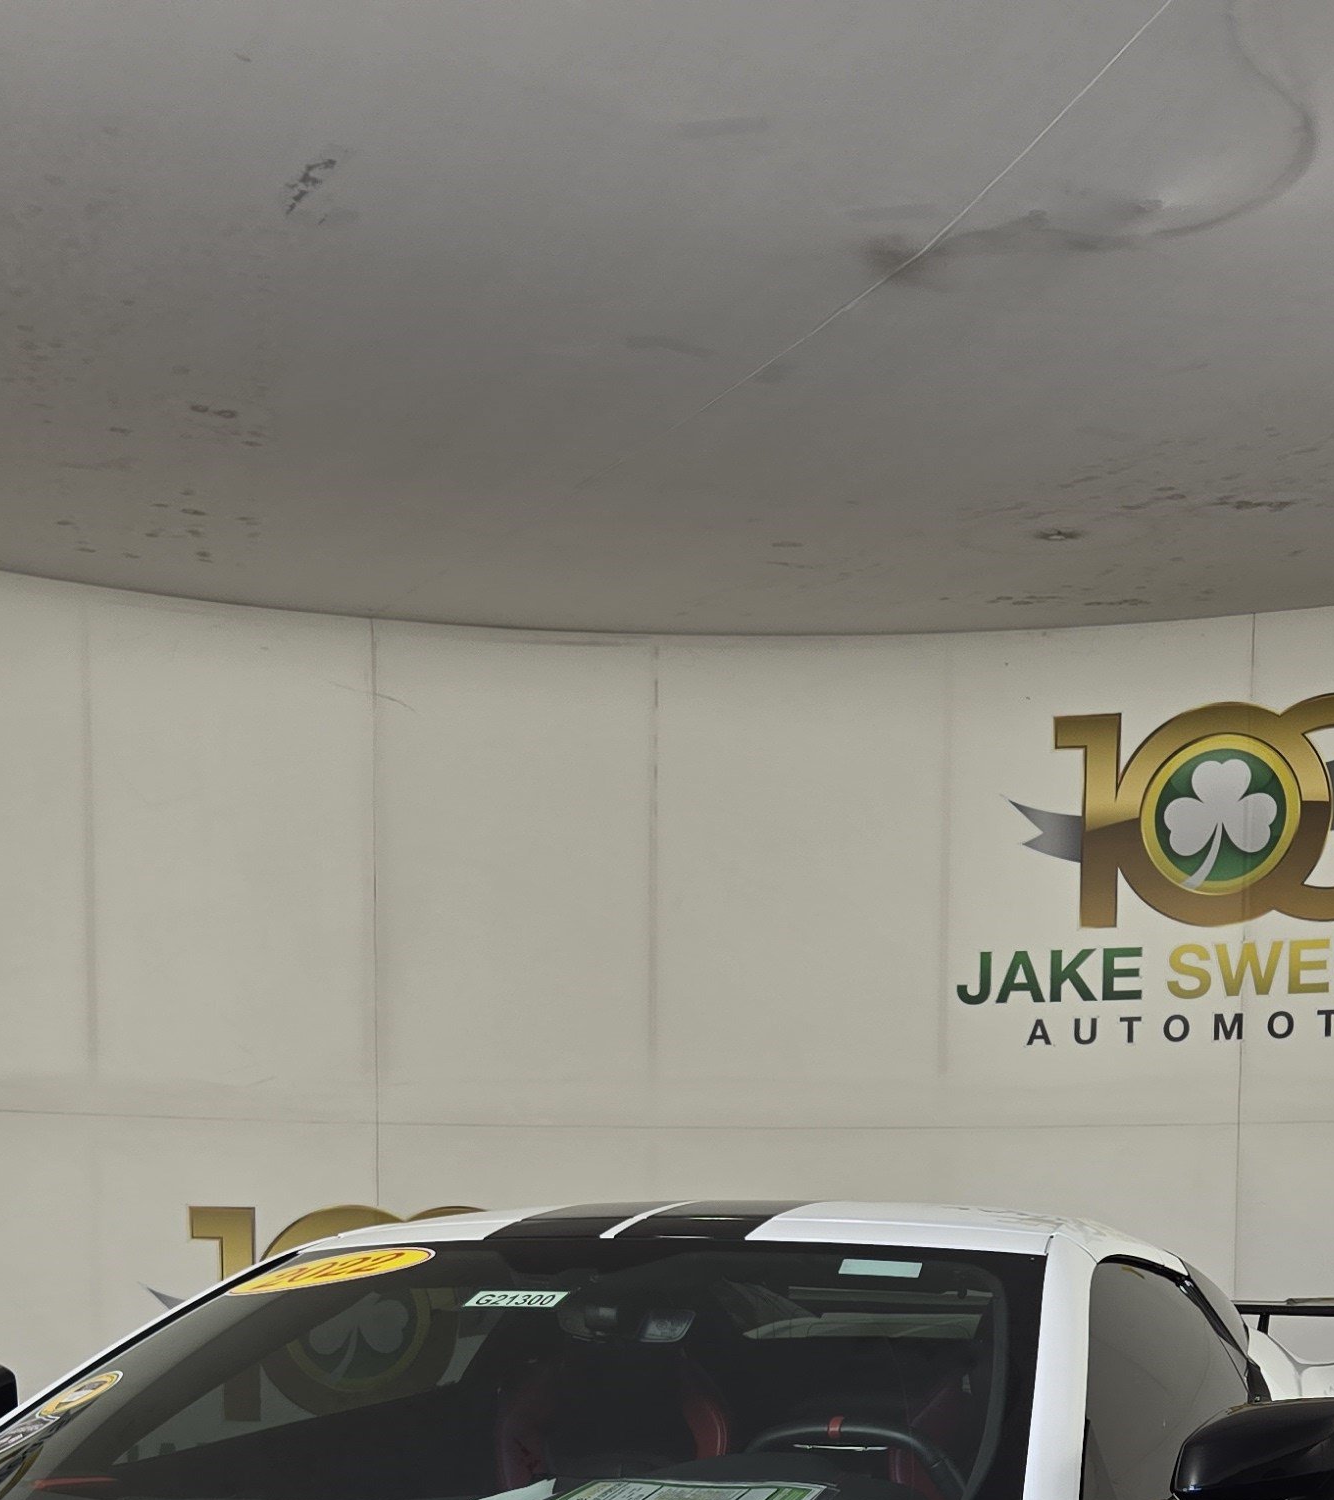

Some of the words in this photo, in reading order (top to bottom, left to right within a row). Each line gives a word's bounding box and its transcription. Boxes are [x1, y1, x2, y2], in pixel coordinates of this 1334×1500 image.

[957, 947, 1143, 1005] JAKE
[251, 1252, 405, 1289] 2022
[476, 1294, 555, 1305] G21300
